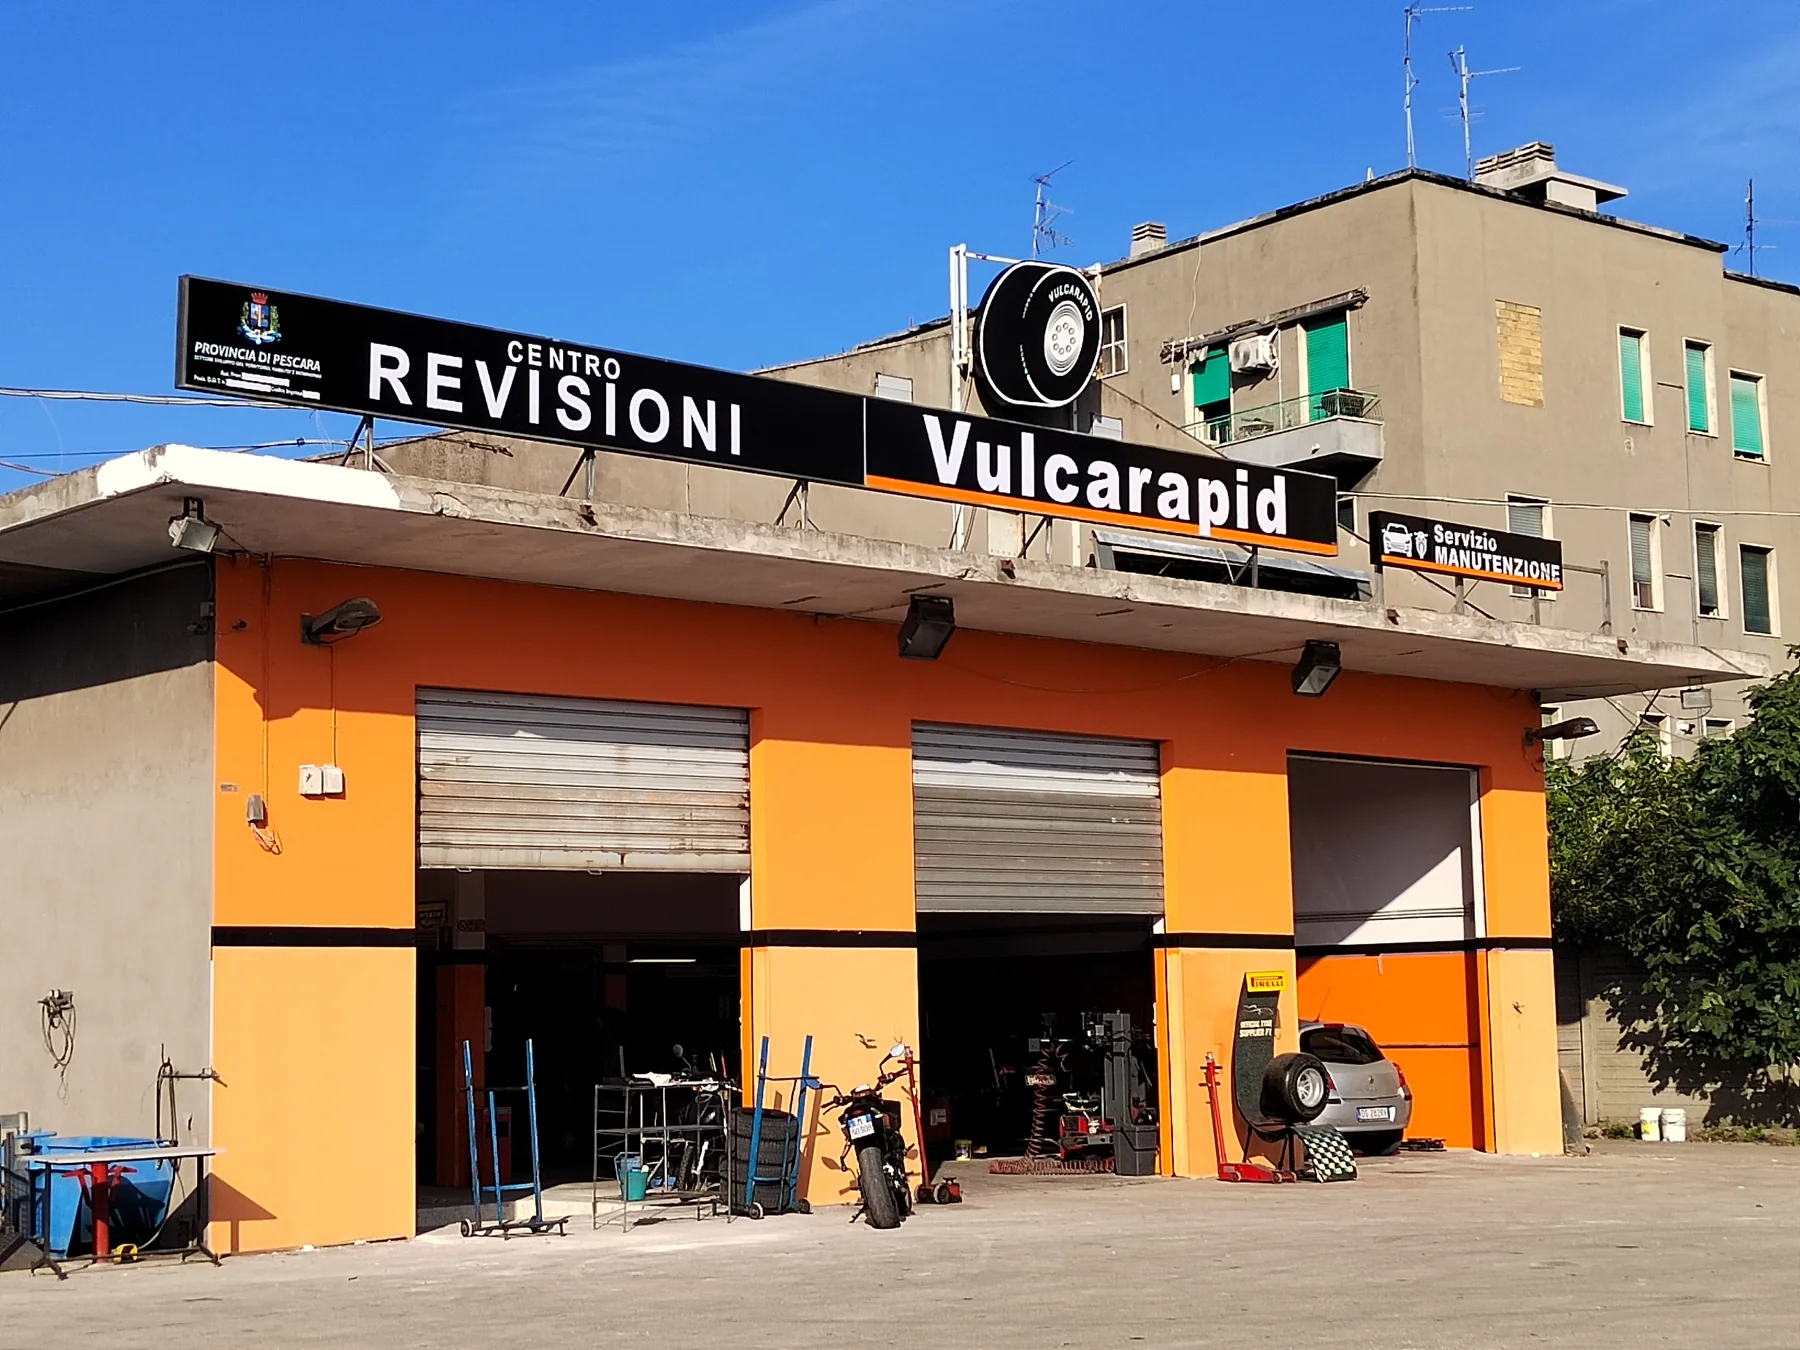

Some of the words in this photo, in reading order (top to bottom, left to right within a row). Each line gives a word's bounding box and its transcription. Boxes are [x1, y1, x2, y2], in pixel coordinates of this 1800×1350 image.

[1048, 283, 1093, 321] VULCARAPID
[194, 341, 256, 362] PROVINCIA
[258, 350, 271, 364] DI
[273, 353, 321, 372] PESCARA
[507, 340, 621, 380] CENTRO
[369, 342, 741, 456] REVISIONI
[922, 413, 1287, 537] Vulcarapid
[1433, 523, 1498, 552] Servizio
[1434, 545, 1561, 583] MANUTENZIONE
[1250, 975, 1284, 987] PIRELLI
